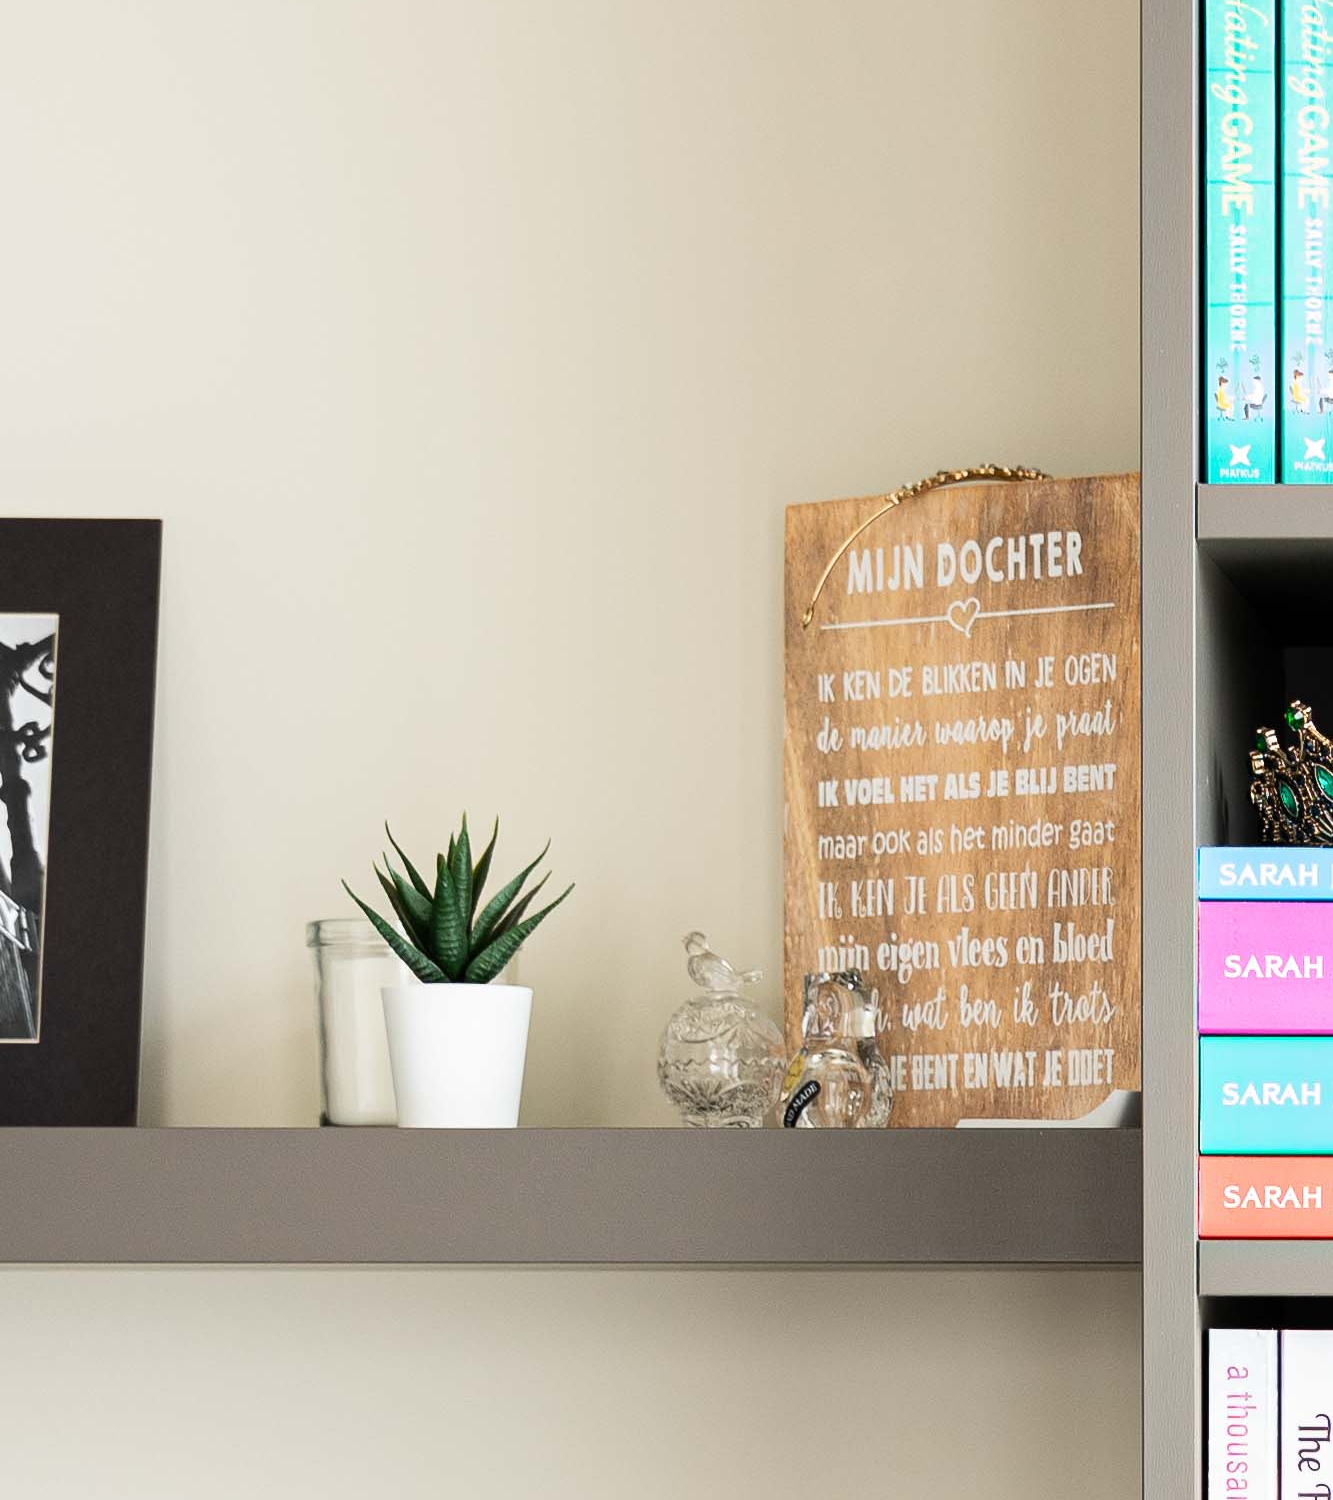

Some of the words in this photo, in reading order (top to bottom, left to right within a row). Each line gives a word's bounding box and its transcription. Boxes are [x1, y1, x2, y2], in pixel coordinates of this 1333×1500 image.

[848, 543, 923, 593] MIJN
[936, 531, 1083, 587] DOCHTER
[819, 779, 838, 807] IK
[845, 776, 894, 805] VOEL
[900, 773, 937, 803] HET
[944, 771, 981, 800] ALS
[987, 770, 1009, 798] JE
[1016, 767, 1056, 796] BLIJ
[1064, 764, 1116, 792] BENT
[818, 833, 865, 860] maar
[873, 828, 910, 856] ook
[916, 827, 943, 855] als
[950, 824, 984, 852] het
[992, 820, 1061, 849] minder
[1068, 819, 1115, 850] gaat
[1224, 1185, 1324, 1208] SARAH
[1297, 1414, 1331, 1472] The
